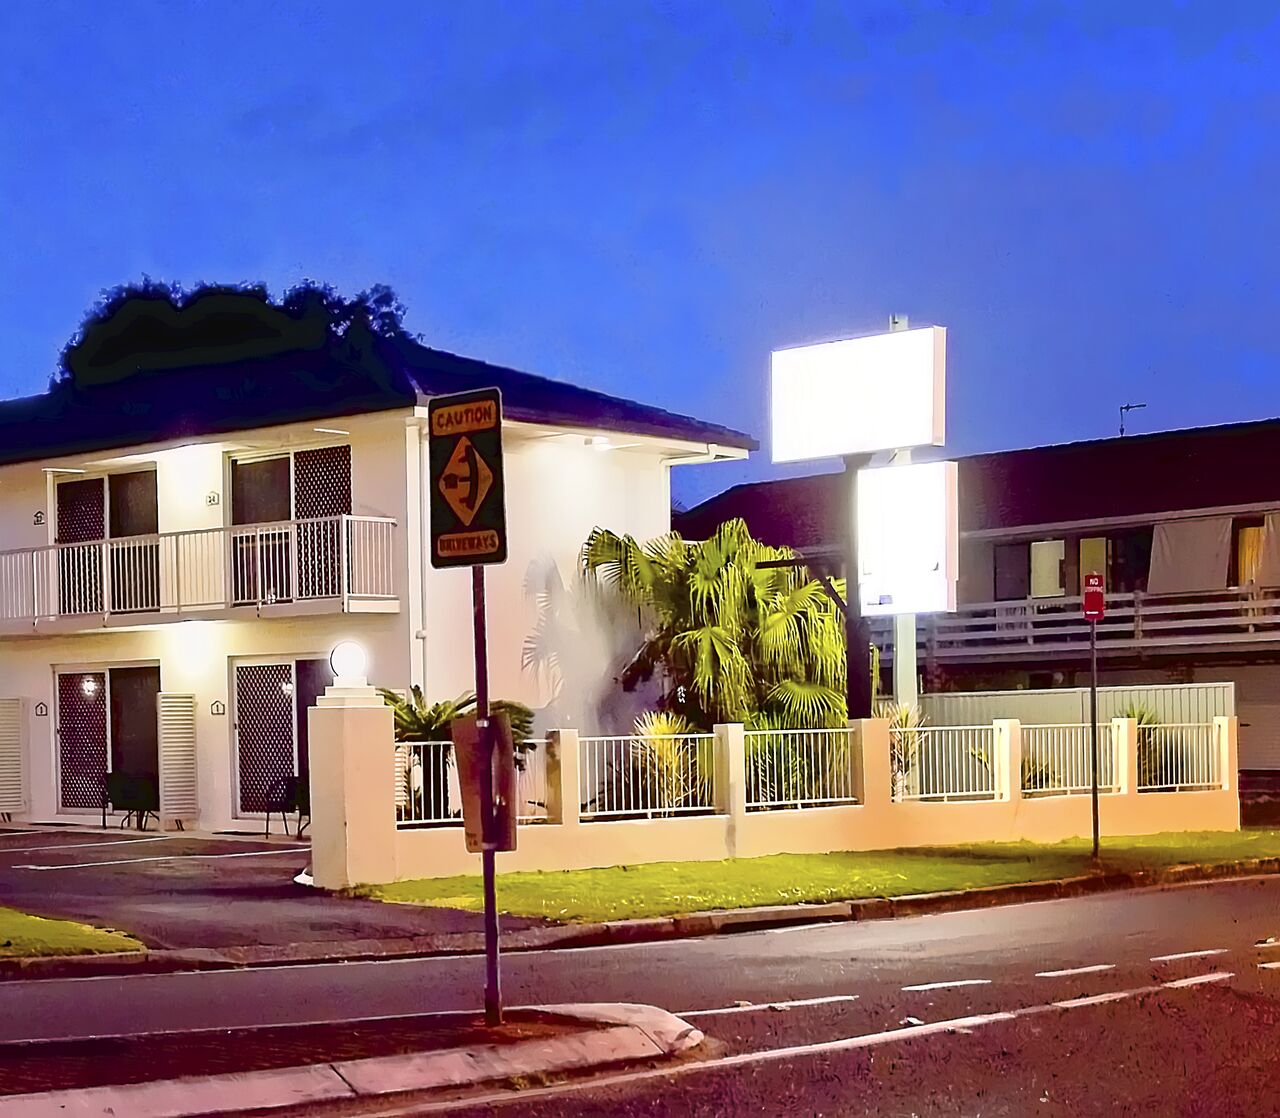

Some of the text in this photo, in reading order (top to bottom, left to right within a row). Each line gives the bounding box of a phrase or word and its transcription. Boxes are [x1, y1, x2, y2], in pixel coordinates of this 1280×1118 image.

[437, 405, 492, 428] CAUTION
[439, 533, 497, 552] DRIVEWAYS
[1090, 577, 1099, 586] NO
